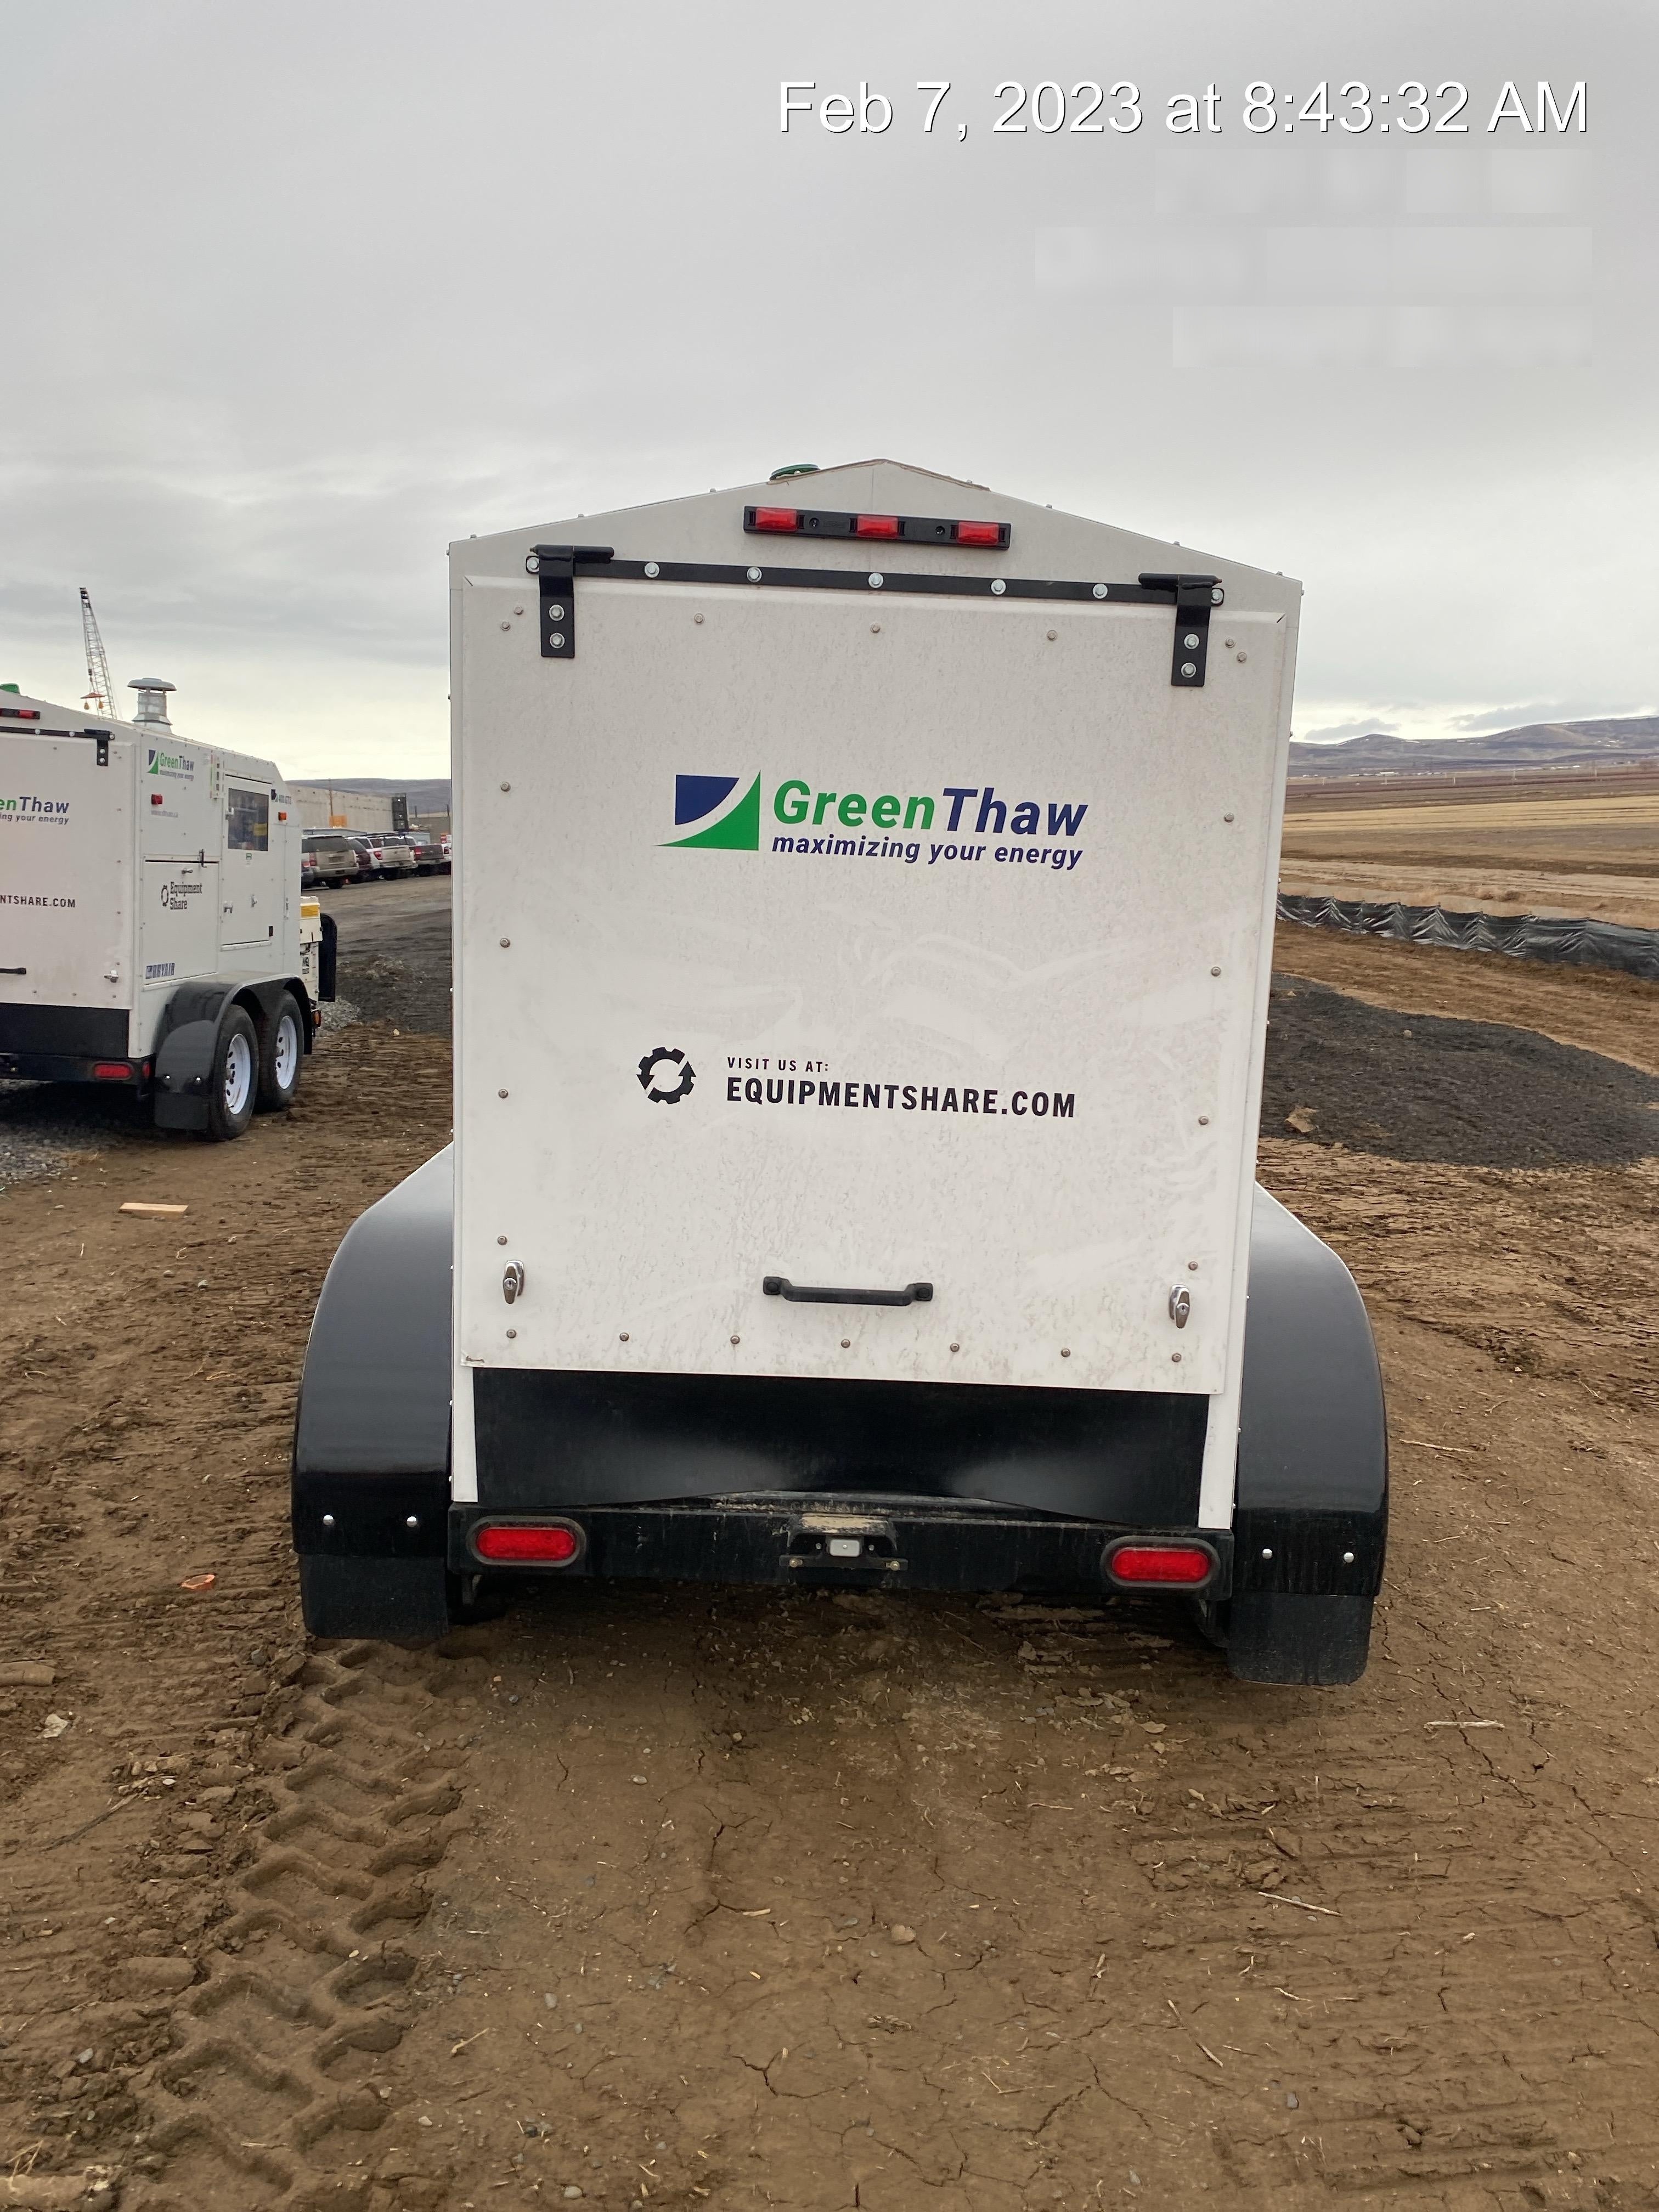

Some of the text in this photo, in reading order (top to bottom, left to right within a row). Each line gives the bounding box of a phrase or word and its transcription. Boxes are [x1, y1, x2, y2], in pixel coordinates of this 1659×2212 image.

[38, 816, 69, 825] energy
[774, 780, 1088, 837] GreenThaw
[772, 833, 1084, 871] maximizing your energy
[727, 1057, 829, 1073] VISIT US AT:
[727, 1077, 1075, 1118] EQUIPMENTSHARE.COM
